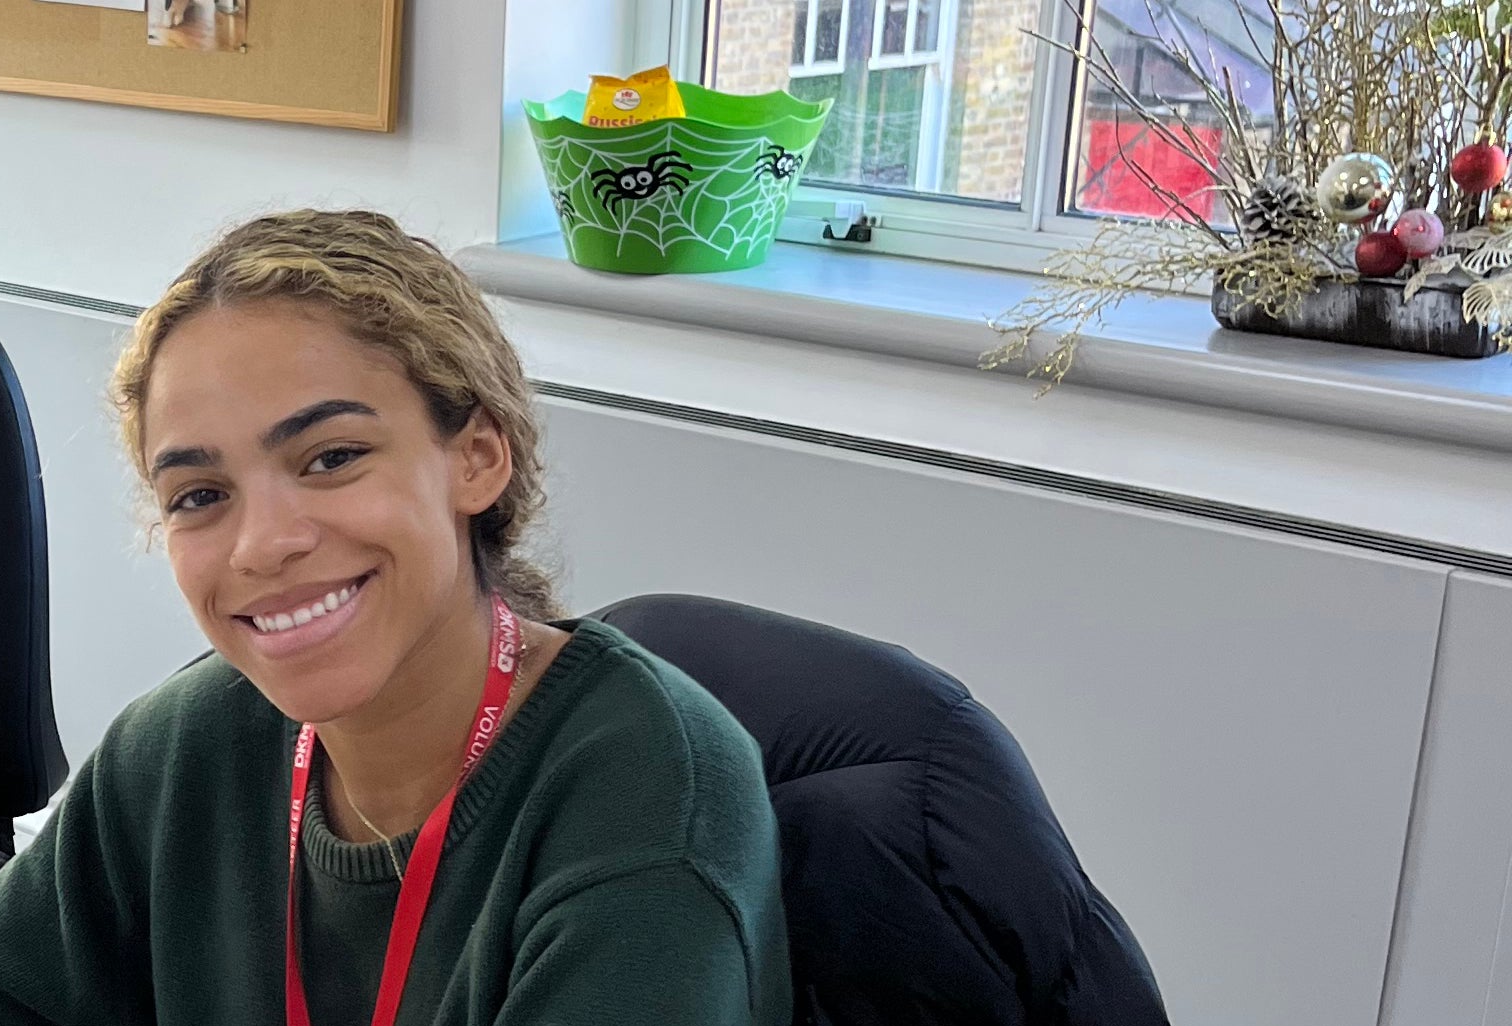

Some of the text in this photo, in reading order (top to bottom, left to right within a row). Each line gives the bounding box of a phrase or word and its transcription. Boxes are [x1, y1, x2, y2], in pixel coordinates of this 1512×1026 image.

[460, 605, 516, 772] DKMS VOLUN
[294, 722, 311, 768] DKM
